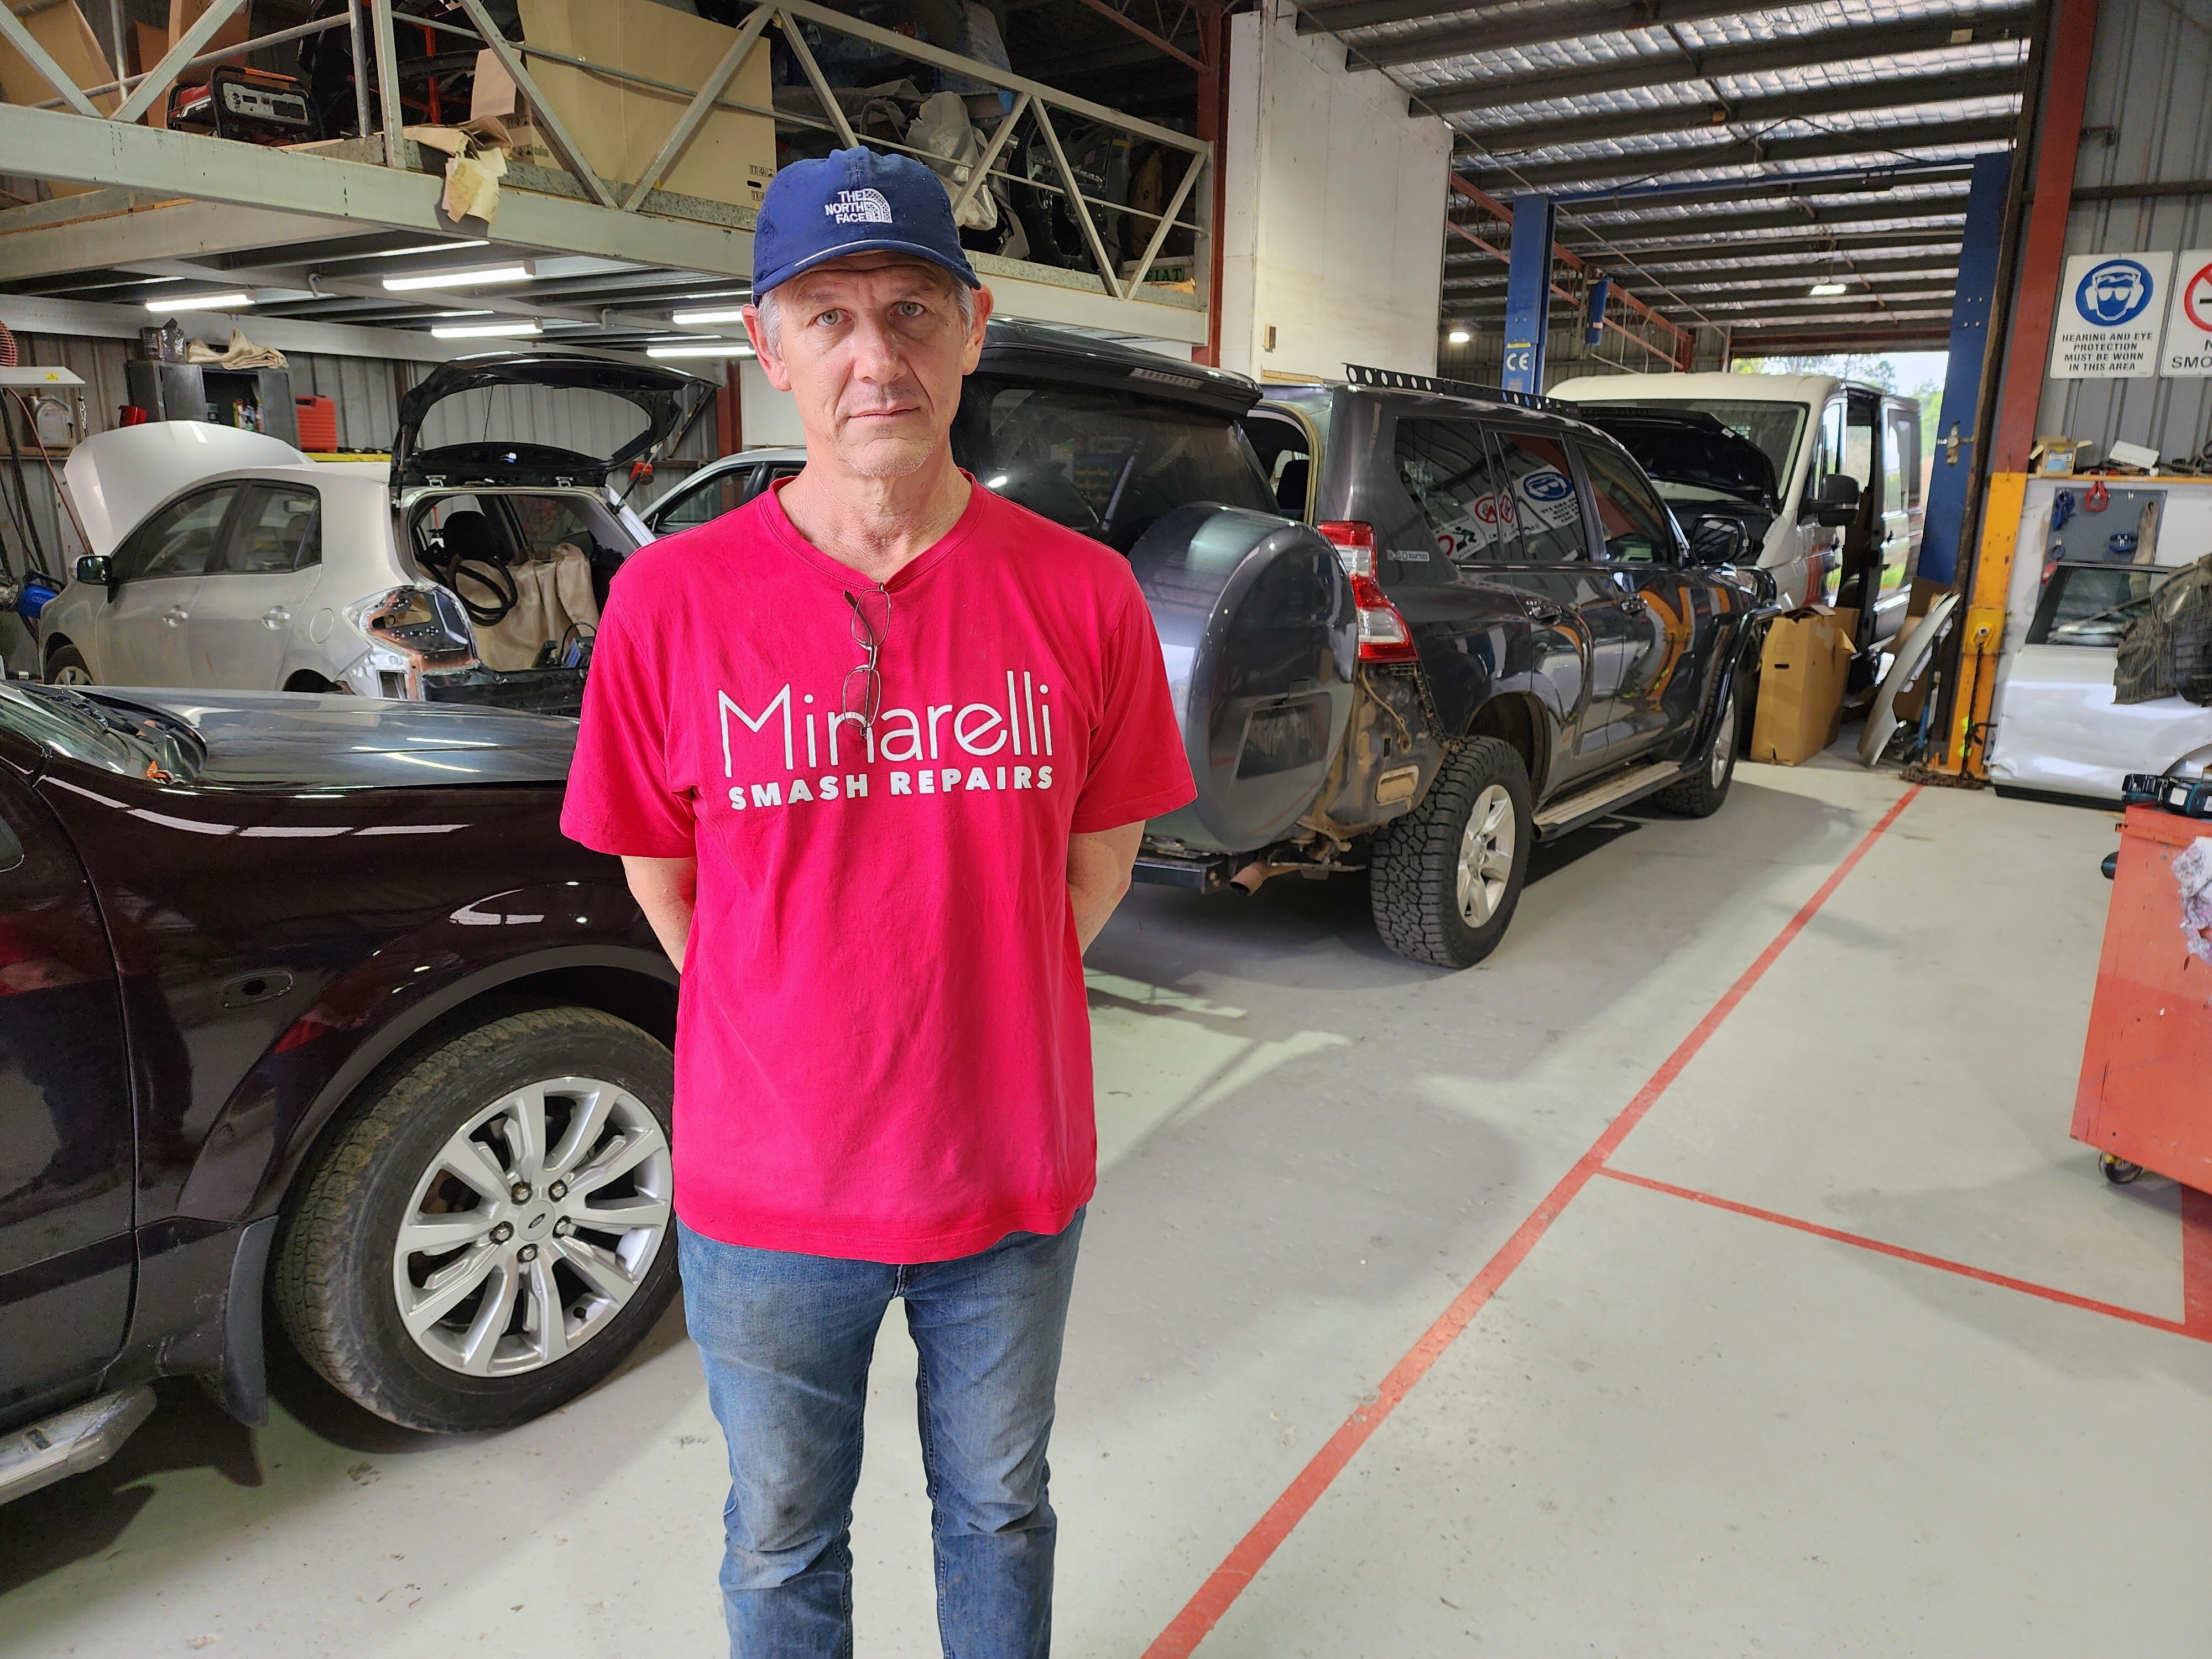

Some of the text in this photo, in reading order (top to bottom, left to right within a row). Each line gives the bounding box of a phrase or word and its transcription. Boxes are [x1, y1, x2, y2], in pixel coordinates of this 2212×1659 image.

[837, 190, 864, 202] THE
[824, 201, 864, 216] NORTH
[836, 212, 865, 225] FACE
[2062, 332, 2153, 342] HEARING AND EYE
[2074, 342, 2137, 352] PROTECTION
[2064, 353, 2093, 362] MUST
[2113, 352, 2144, 361] WORN
[2069, 362, 2136, 371] IN THIS AREA
[718, 671, 1052, 778] Minarelli
[728, 765, 1053, 811] SMASH REPAIRS
